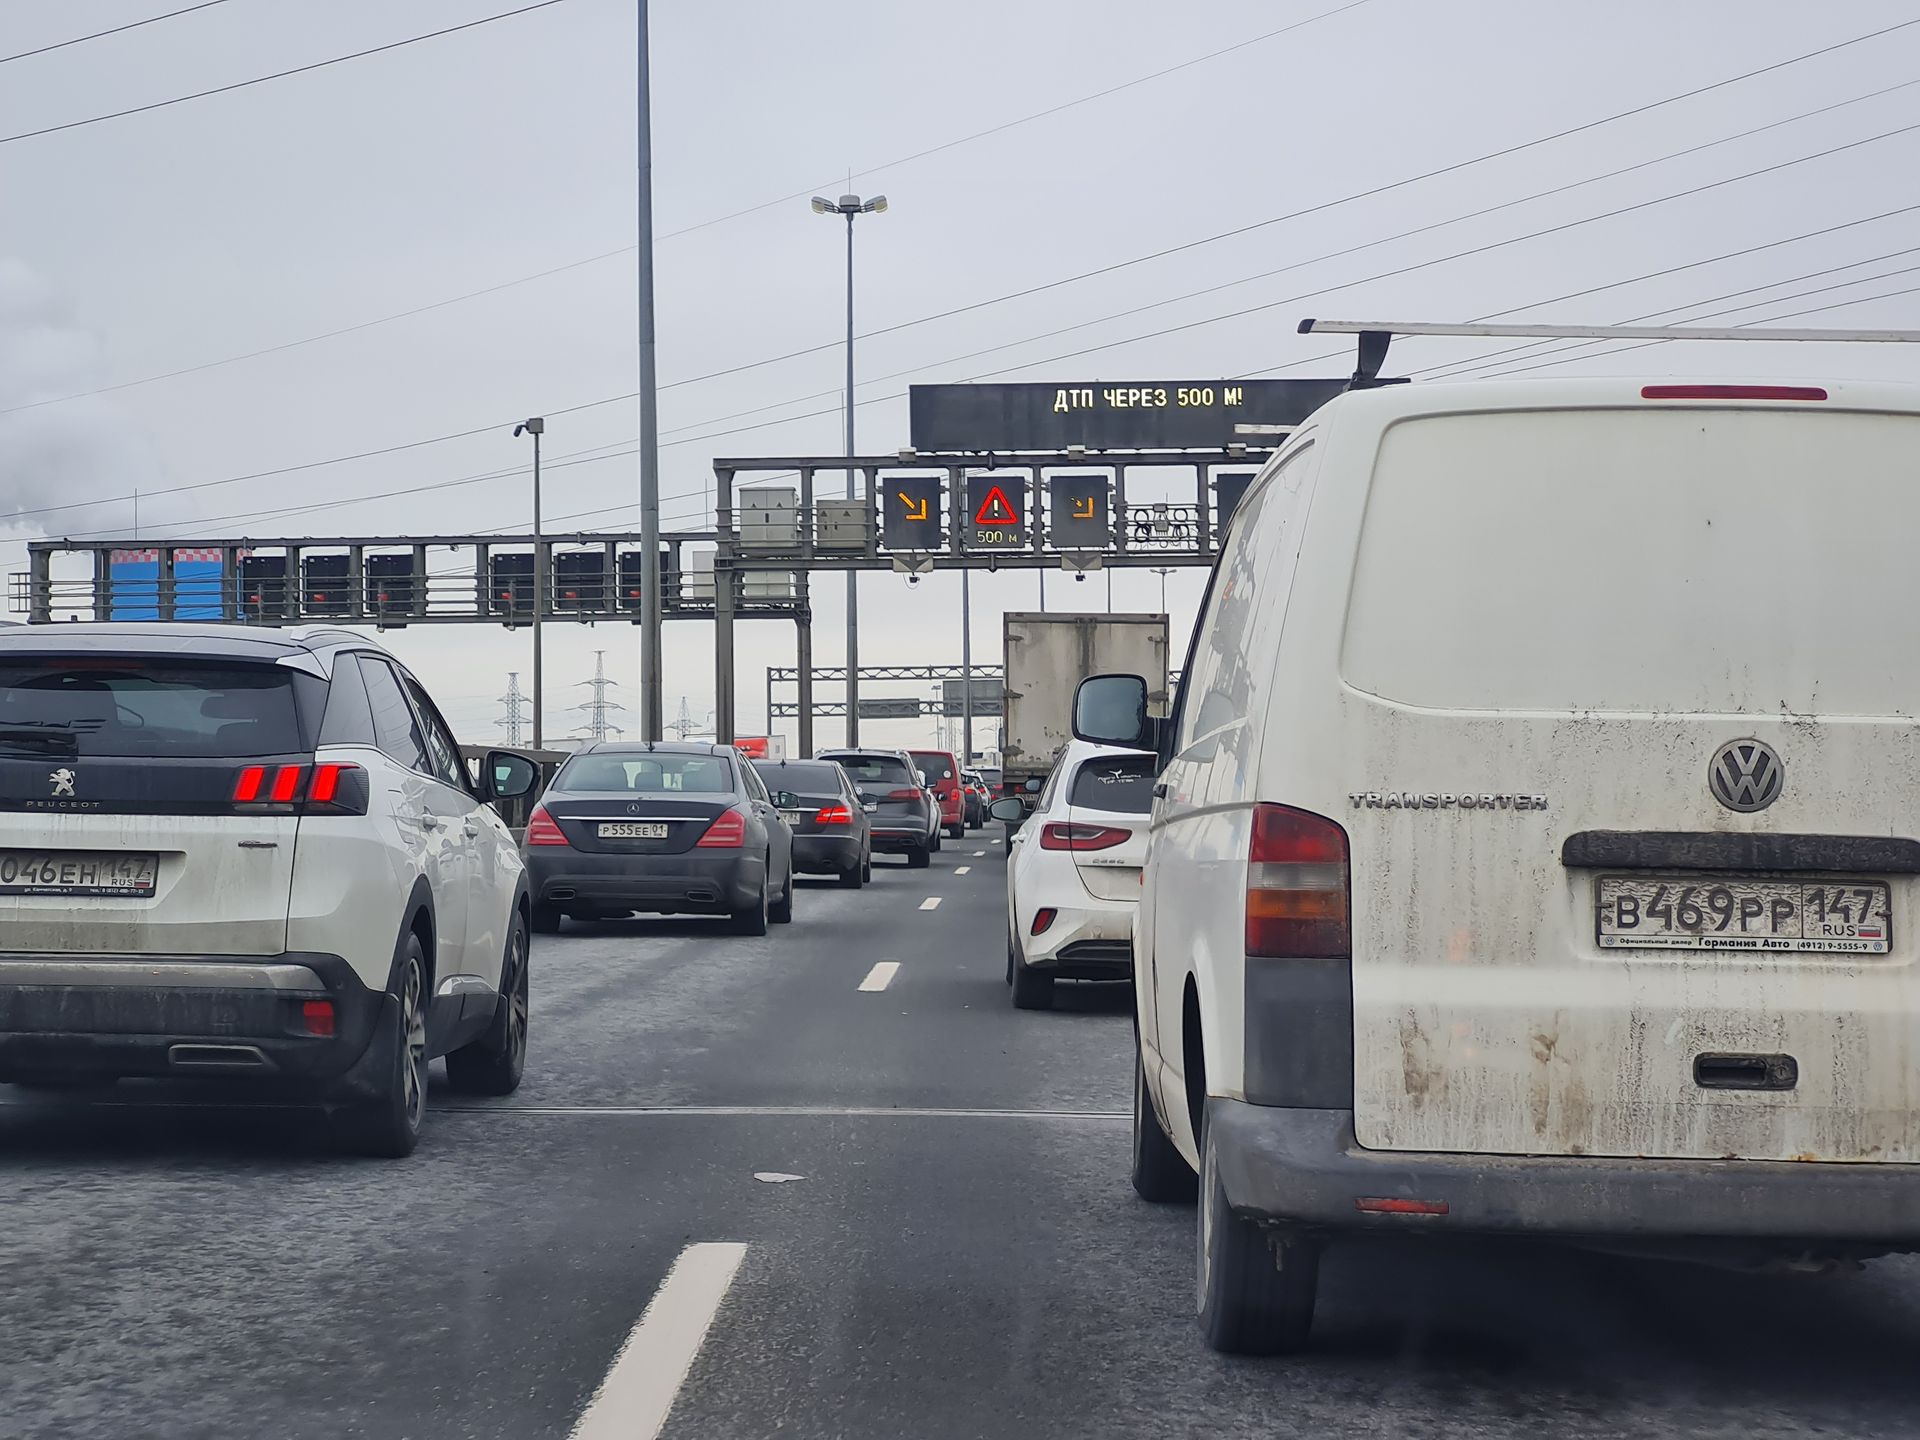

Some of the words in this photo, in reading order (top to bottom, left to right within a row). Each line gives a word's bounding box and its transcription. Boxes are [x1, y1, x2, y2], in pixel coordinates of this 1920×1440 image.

[1054, 389, 1094, 413] ДТП
[1103, 388, 1168, 408] ЧЕРЕЗ
[1177, 388, 1214, 407] 500
[1224, 387, 1243, 406] М!
[976, 530, 1003, 543] 500
[1349, 791, 1549, 811] TRANSPORTER
[111, 877, 134, 888] RUS
[1807, 889, 1874, 924] 147
[1822, 923, 1856, 937] RUS
[1698, 937, 1758, 950] Германия
[1762, 938, 1791, 950] Авто
[1797, 941, 1826, 951] (4912)
[1827, 942, 1869, 951] 9-5555-9
